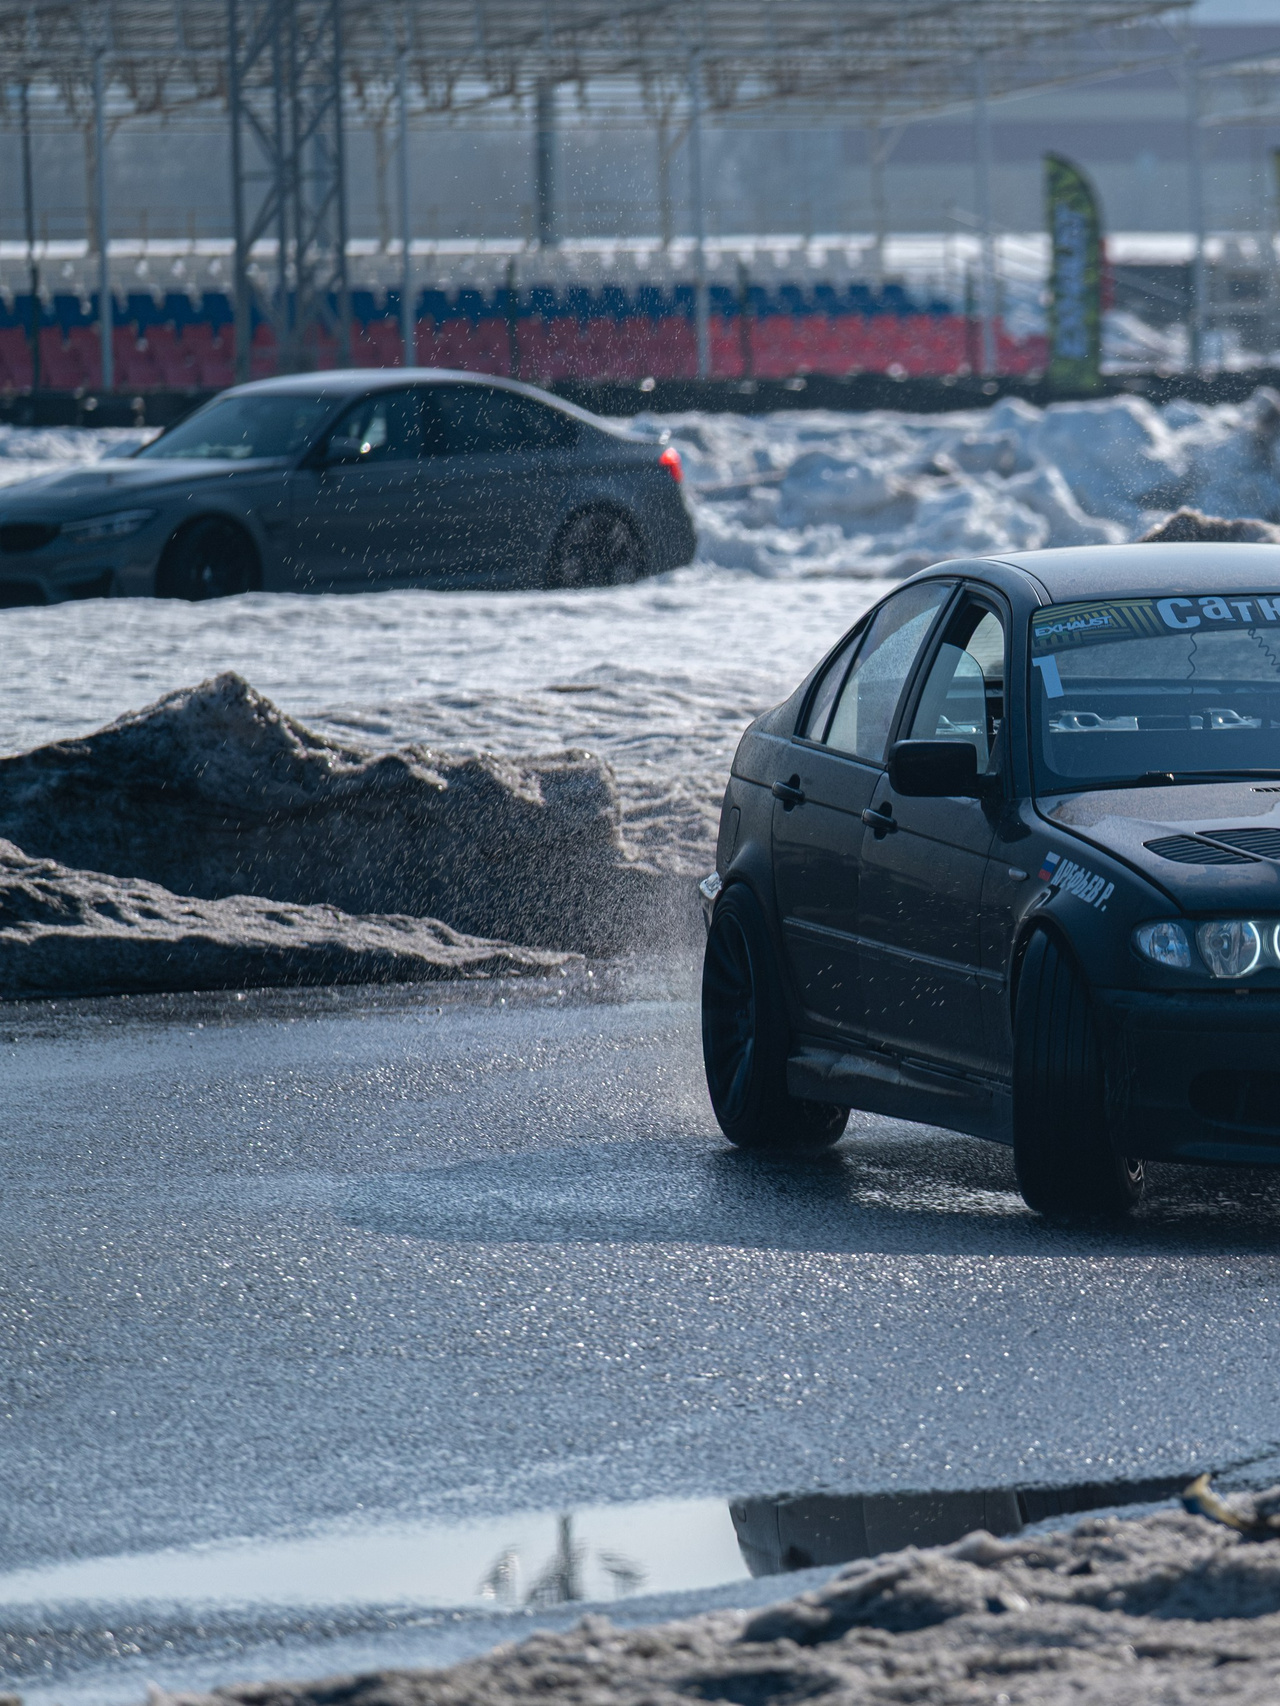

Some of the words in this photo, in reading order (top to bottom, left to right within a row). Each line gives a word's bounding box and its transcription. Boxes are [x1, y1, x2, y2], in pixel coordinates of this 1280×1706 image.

[1035, 616, 1112, 637] EXHAUST
[1032, 655, 1064, 699] 1
[1051, 860, 1105, 903] АРЕФЬЕВ
